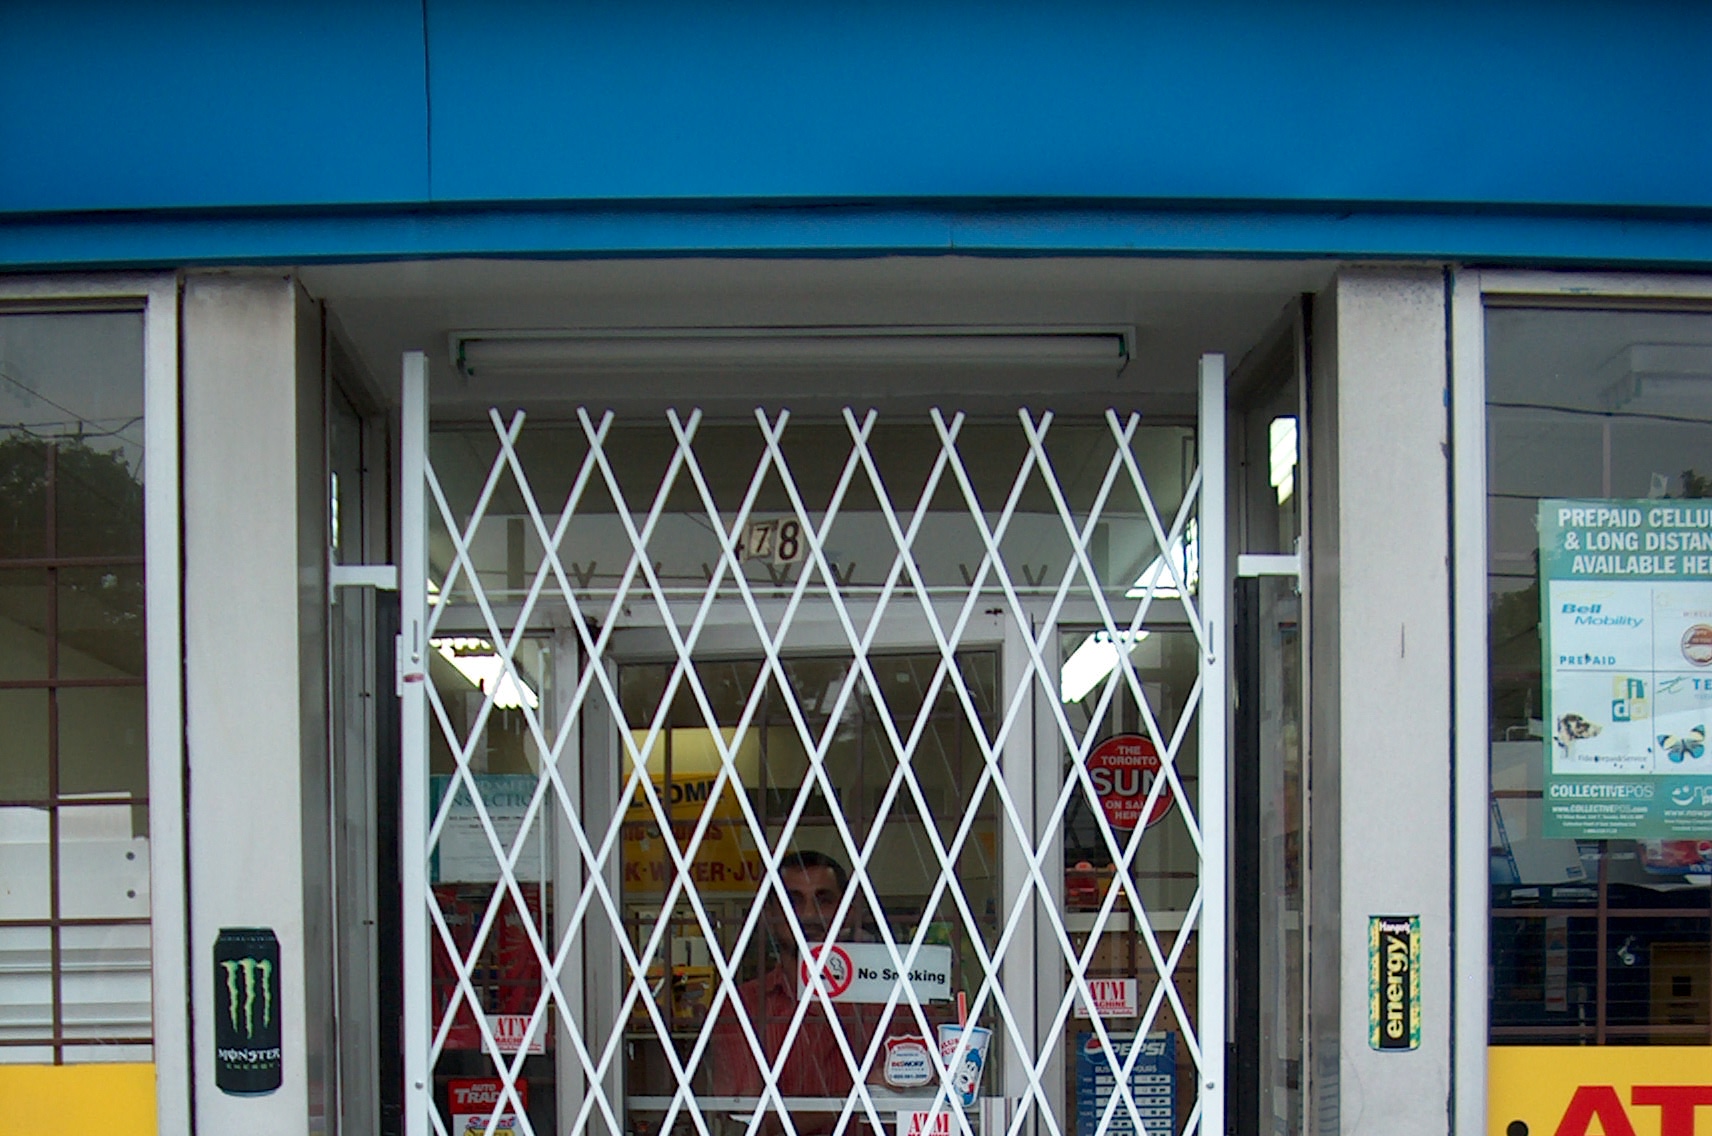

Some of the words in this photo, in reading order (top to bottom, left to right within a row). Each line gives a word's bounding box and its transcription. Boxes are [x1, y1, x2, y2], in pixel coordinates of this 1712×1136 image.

[1557, 507, 1642, 528] PREPAID
[1648, 507, 1712, 528] CELLU
[1564, 531, 1580, 550] &
[1586, 531, 1638, 551] LONG
[1571, 555, 1677, 574] AVAILABLE
[1682, 555, 1712, 574] HE
[1561, 603, 1602, 614] Bell
[1574, 616, 1644, 628] Mobility
[1559, 655, 1617, 666] PREPAID
[1117, 745, 1141, 755] THE
[1101, 755, 1158, 766] TORONTO
[1090, 767, 1167, 796] SUN
[1550, 784, 1654, 798] COLLECTIVEPOS
[1105, 801, 1122, 809] ON
[1115, 811, 1140, 820] HER
[858, 968, 878, 980] No
[1387, 934, 1409, 1039] energy
[218, 1048, 281, 1062] MONSTER
[470, 1084, 497, 1092] AUTO
[454, 1087, 523, 1104] TRA
